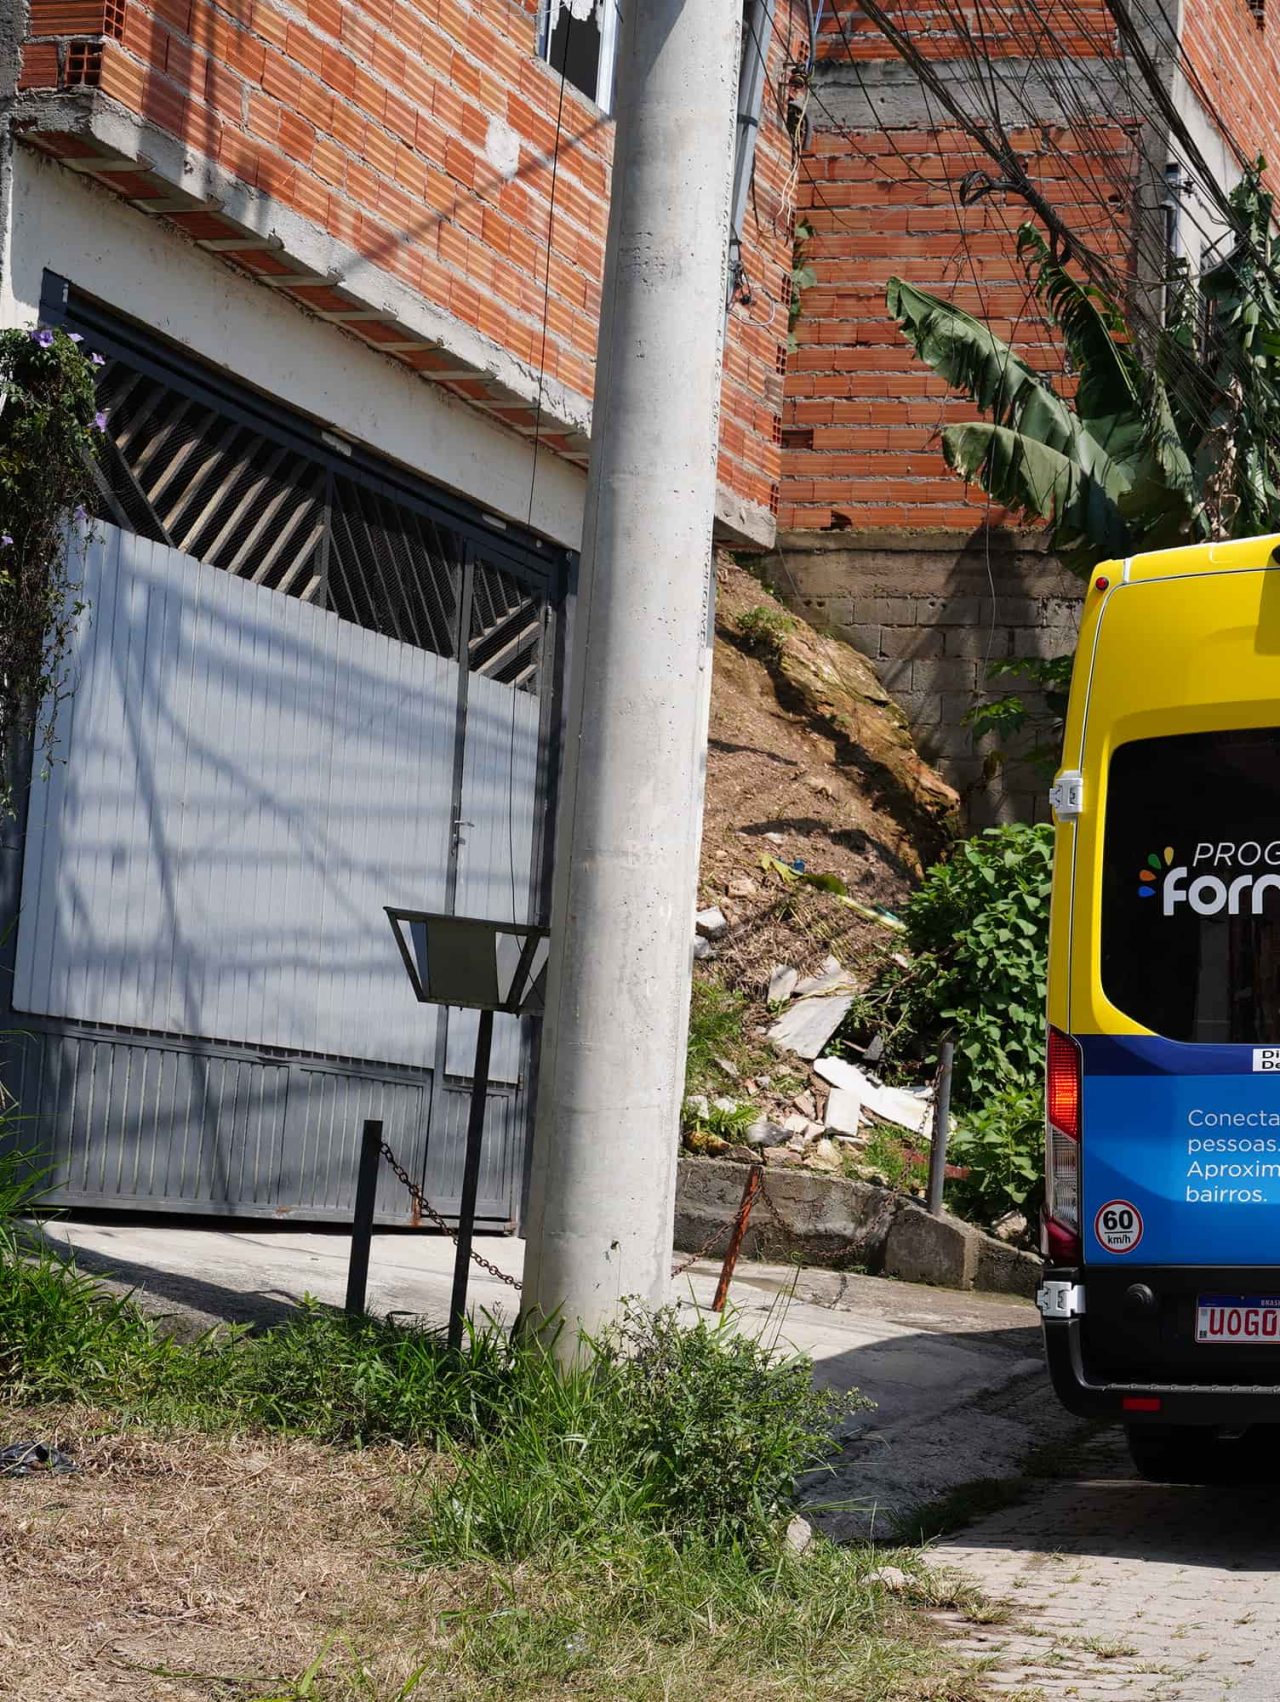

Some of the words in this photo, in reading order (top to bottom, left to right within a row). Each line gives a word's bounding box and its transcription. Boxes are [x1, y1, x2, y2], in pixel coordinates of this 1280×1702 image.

[1186, 1185, 1268, 1203] bairros.
[1102, 1209, 1134, 1231] 60
[1107, 1233, 1131, 1245] km/h
